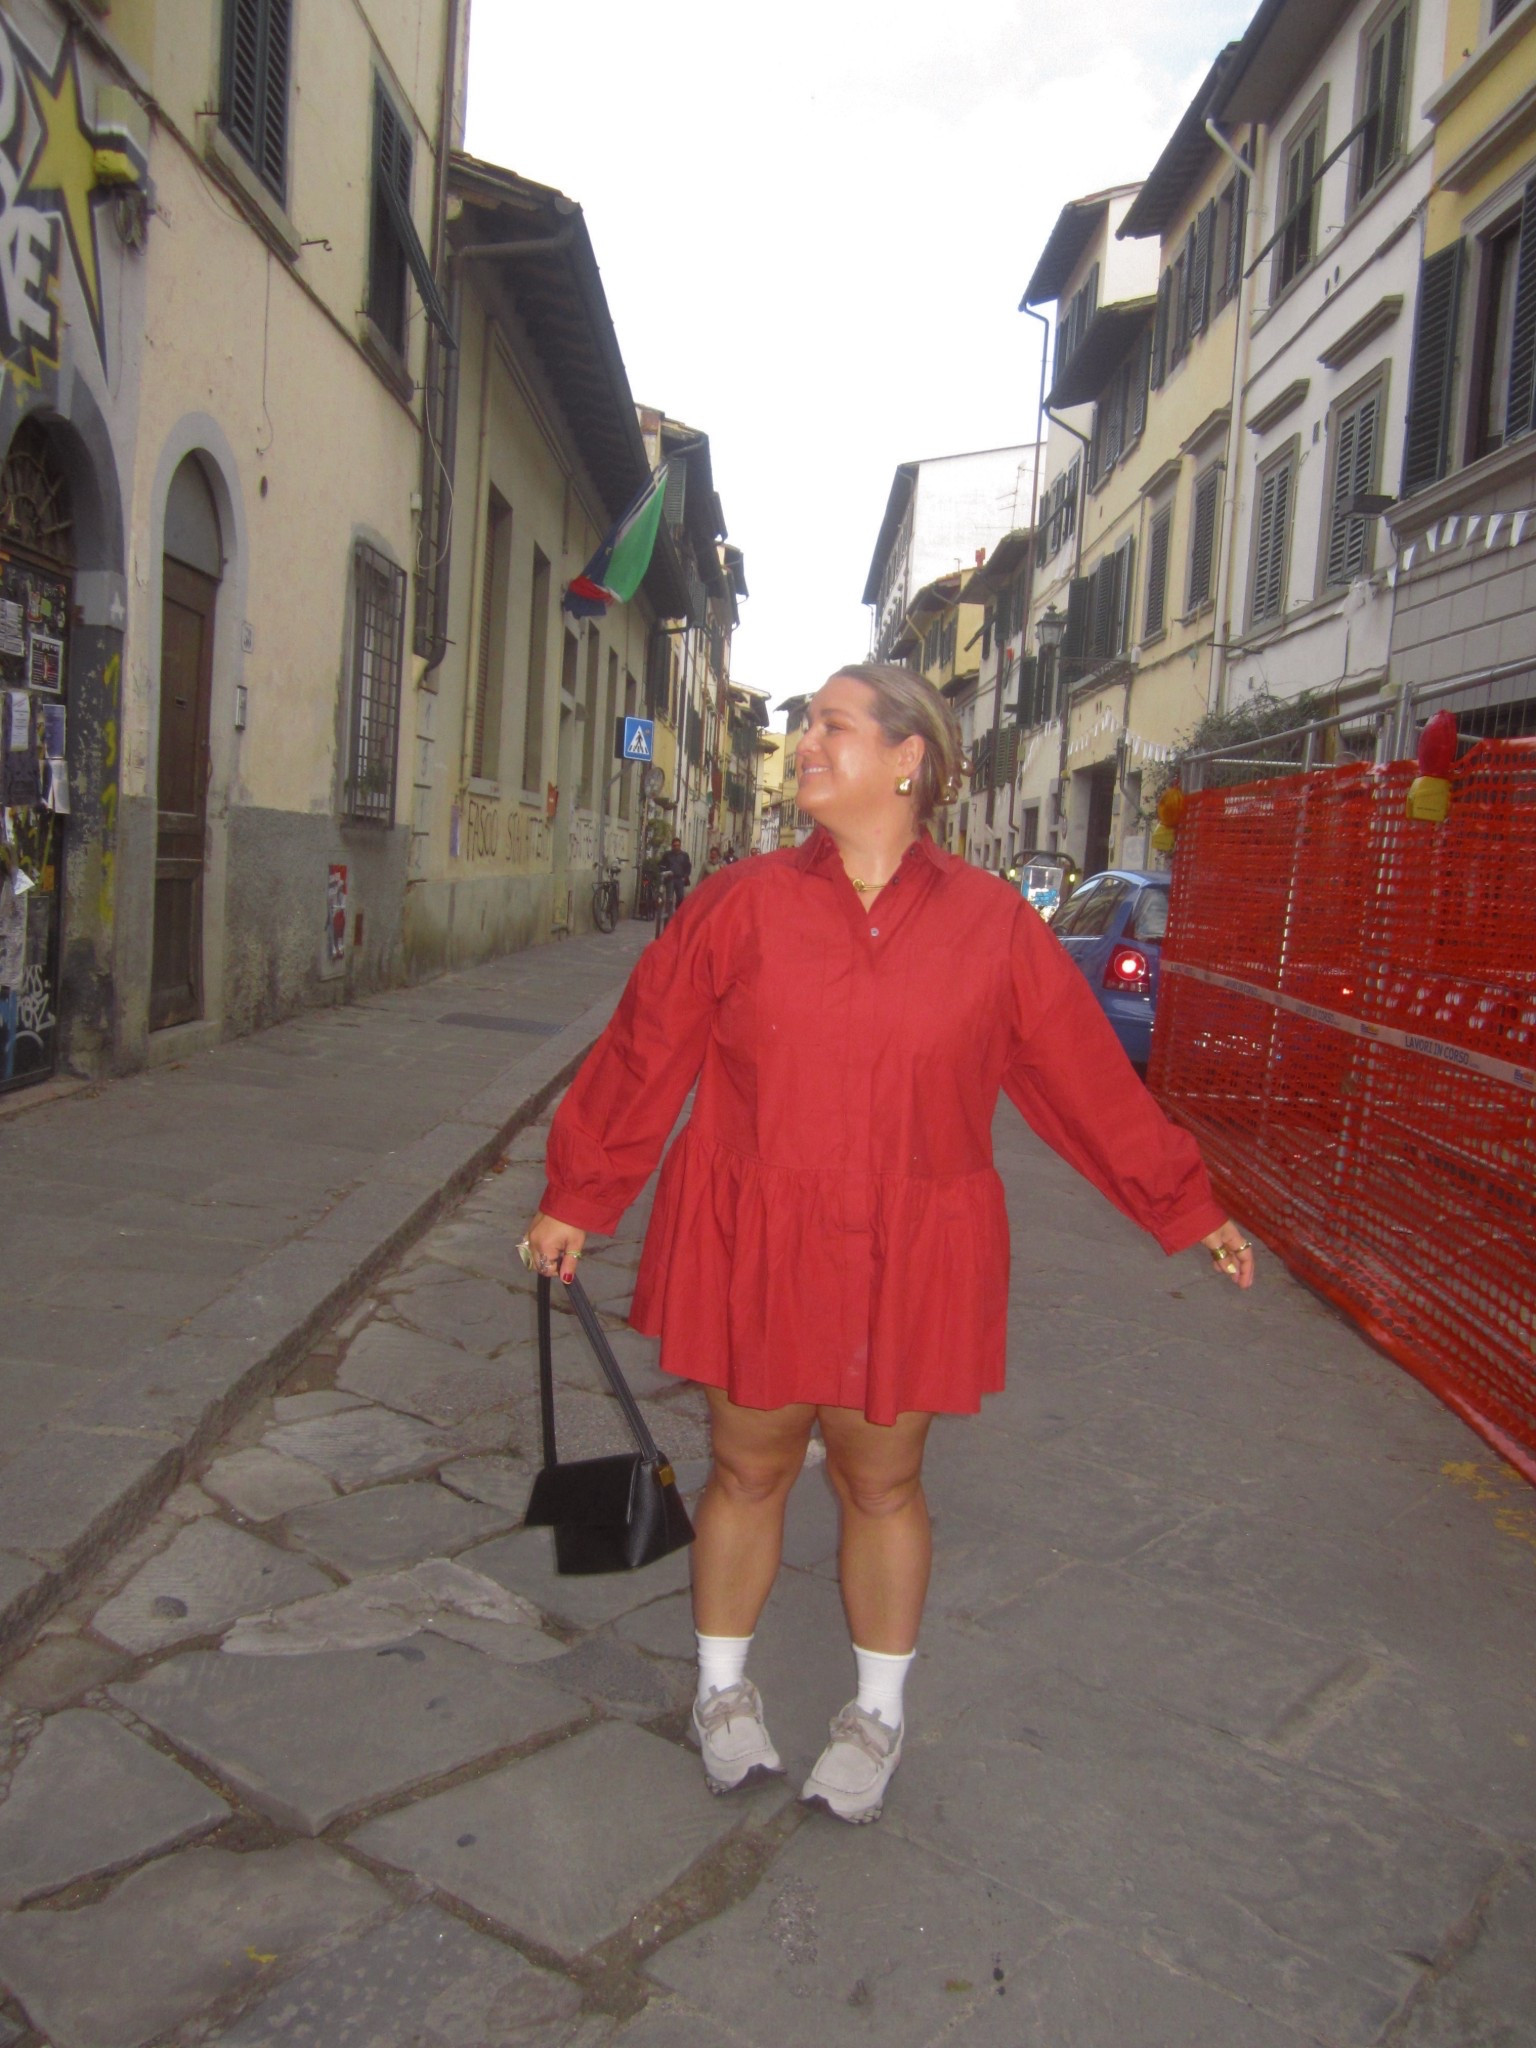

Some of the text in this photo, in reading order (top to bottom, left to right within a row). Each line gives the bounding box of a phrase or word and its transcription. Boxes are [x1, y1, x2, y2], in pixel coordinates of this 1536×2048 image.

[1404, 1035, 1470, 1065] LAVORI IN CORSO
